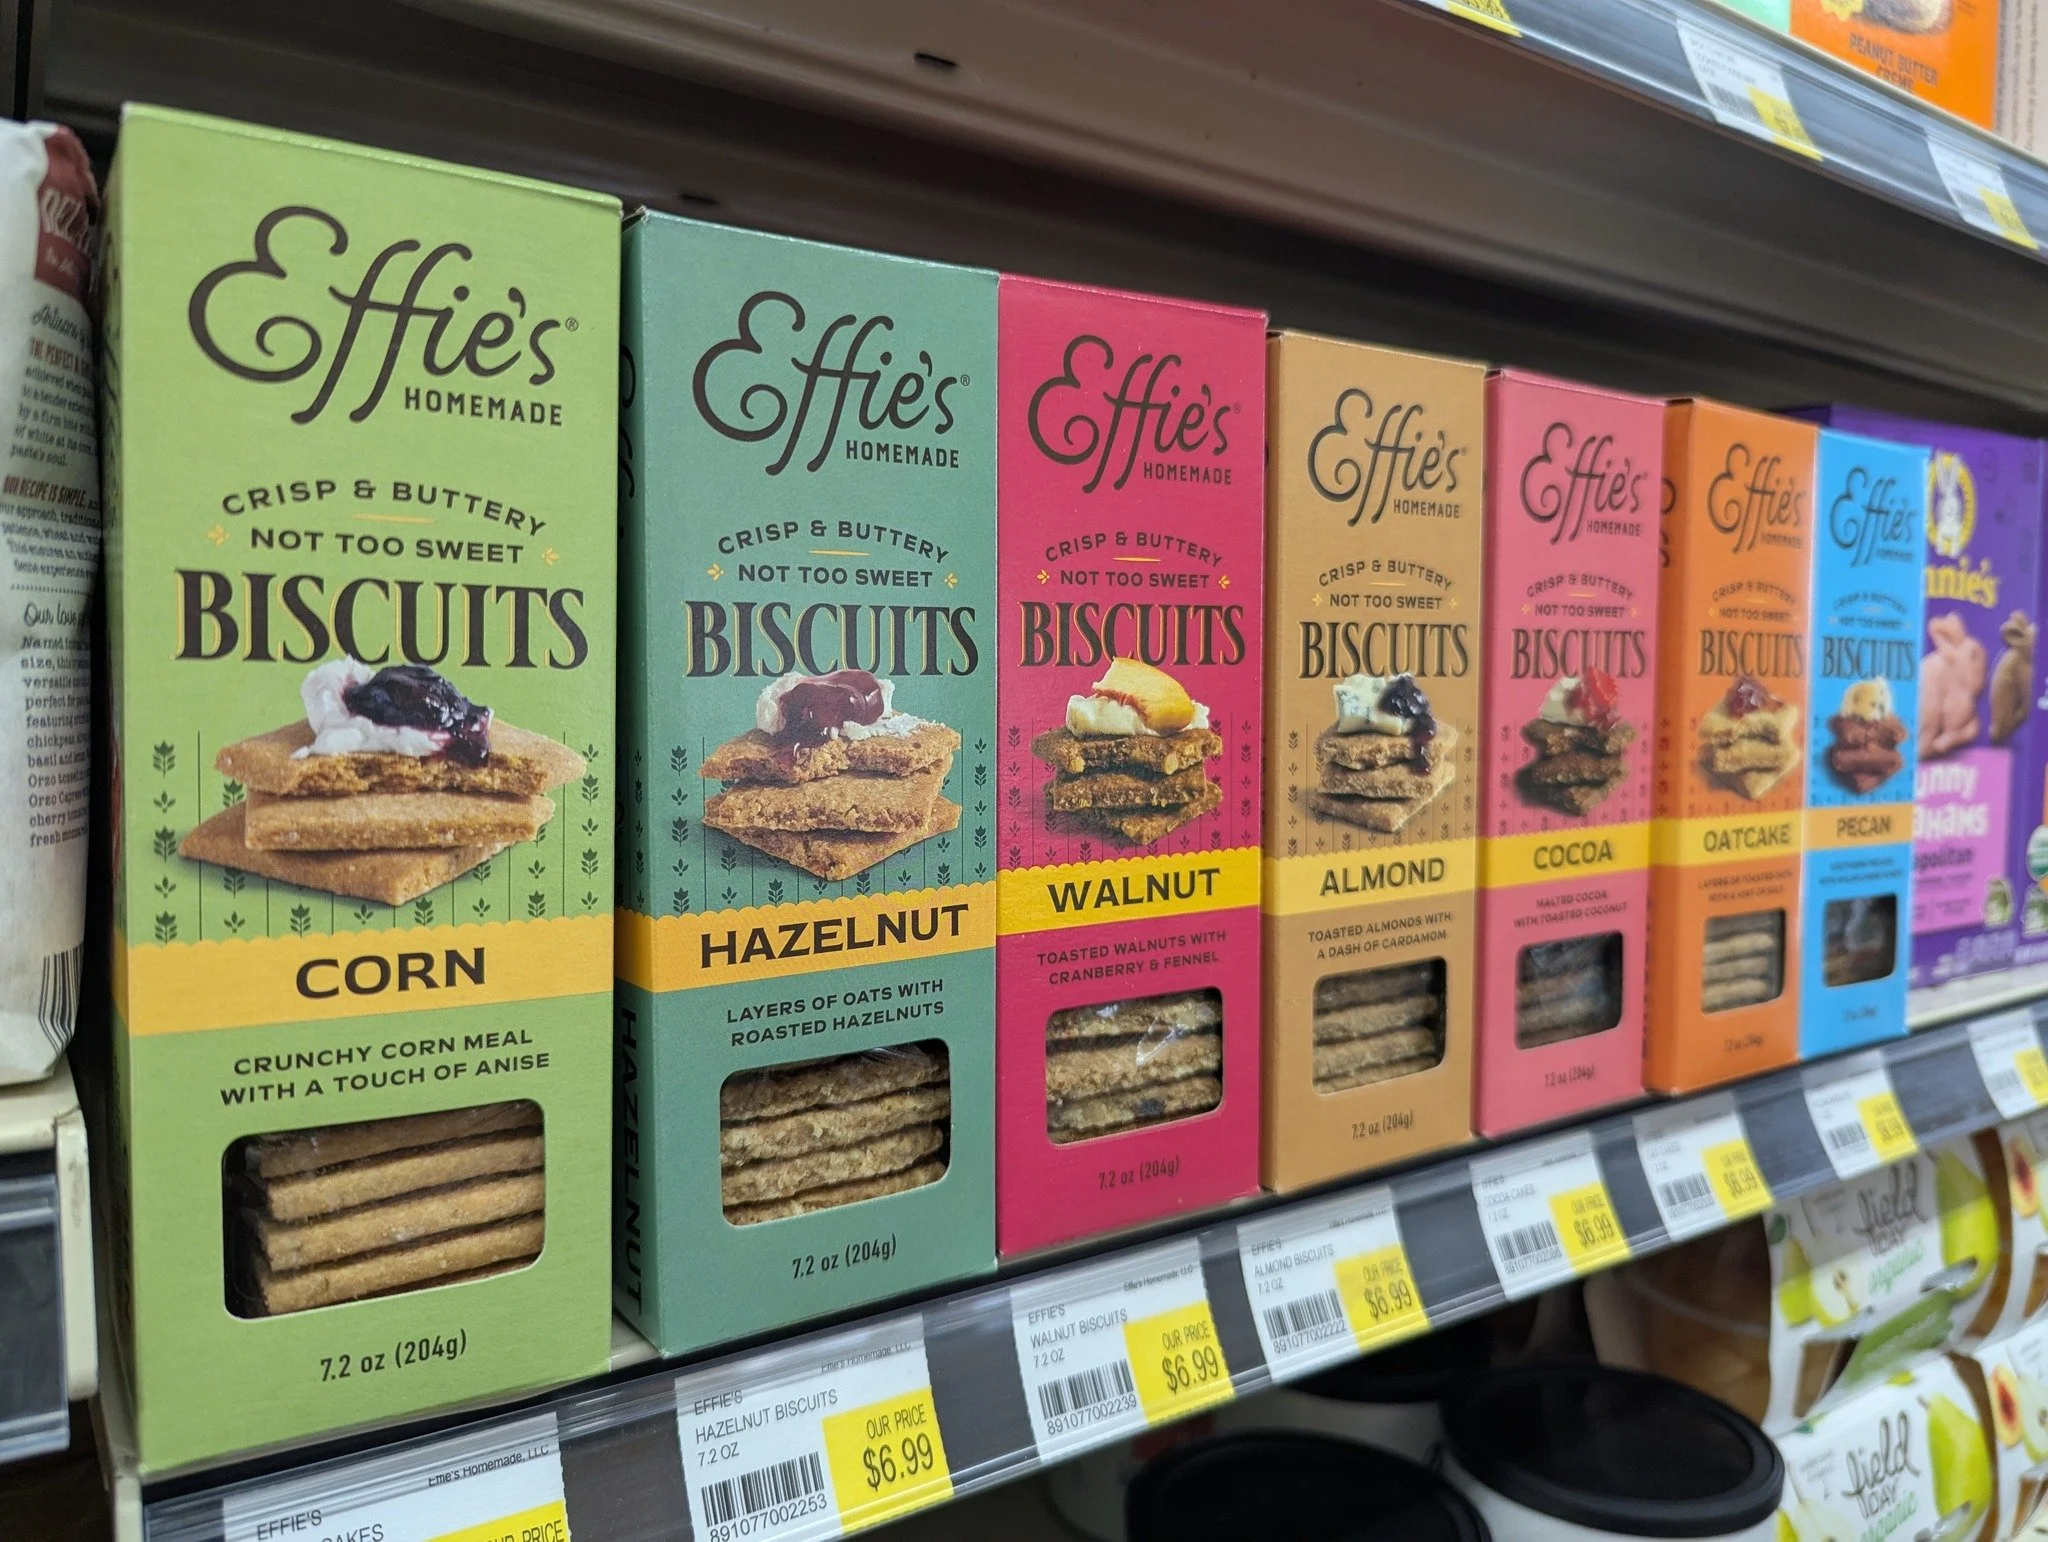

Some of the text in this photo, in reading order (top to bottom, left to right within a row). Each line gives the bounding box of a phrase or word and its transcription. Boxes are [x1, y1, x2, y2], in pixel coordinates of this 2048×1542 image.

[1849, 32, 1939, 87] PEANUT BUTTER
[189, 206, 560, 425] Effie's
[693, 291, 957, 476] Effie's
[404, 386, 563, 427] HOMEMADE
[1028, 335, 1231, 494] Effie's
[846, 440, 960, 468] HOMEMADE
[1143, 462, 1232, 486] HOMEMADE
[1306, 388, 1460, 527] Effie's
[1519, 422, 1642, 545] Effie's
[1707, 443, 1806, 554] Effie's
[222, 479, 548, 538] CRISP & BUTTERY
[1393, 499, 1460, 519] HOMEMADE
[1586, 520, 1641, 537] HOMEMADE
[1829, 467, 1918, 568] Effie's
[251, 528, 525, 564] NOT TOO SWEET
[718, 520, 949, 565] CRISP & BUTTERY
[1045, 531, 1222, 568] CRISP & BUTTERY
[739, 564, 932, 588] NOT TOO SWEET
[1060, 570, 1209, 589] NOT TOO SWEET
[1318, 559, 1452, 591] CRISP & BUTTERY
[1527, 575, 1563, 598] CRISP
[1581, 574, 1633, 601] BUTTERY
[173, 569, 590, 670] BISCUITS
[1329, 594, 1443, 610] NOT TOO SWEET
[1535, 604, 1625, 618] NOT TOO SWEET
[684, 600, 979, 677] BISCUITS
[1016, 601, 1246, 667] BISCUITS
[1298, 621, 1469, 679] BISCUITS
[1510, 628, 1646, 679] BISCUITS
[1698, 629, 1804, 678] BISCUITS
[1820, 636, 1914, 680] BISCUITS
[1703, 823, 1791, 852] OATCAKE
[1836, 816, 1891, 838] PECAN
[1319, 856, 1445, 897] ALMOND
[1533, 839, 1613, 871] COCOA
[1047, 867, 1221, 913] WALNUT
[700, 904, 969, 969] HAZELNUT
[1037, 929, 1227, 967] TOASTED WALNUTS WITH
[1308, 911, 1452, 943] TOASTED ALMONDS WITH
[1316, 929, 1447, 960] A DASH OF CARDAMOM
[296, 948, 487, 999] CORN
[1049, 951, 1219, 985] CRANBERRY & FENNEL
[727, 979, 944, 1024] LAYERS OF OATS WITH
[731, 1001, 944, 1047] ROASTED HAZELNUTS
[233, 1030, 533, 1076] CRUNCHY CORN MEAL
[220, 1052, 550, 1106] WITH A TOUCH OF ANISE
[621, 1006, 643, 1314] HAZELNUT
[1099, 1154, 1180, 1190] 7.2 oz (204g)
[1573, 1212, 1614, 1248] $6.99
[793, 1233, 897, 1279] 7.2 oz (204g)
[1254, 1243, 1334, 1278] ALMOND BISCUITS
[1028, 1304, 1065, 1325] EFFIE'S
[1364, 1280, 1413, 1324] $6.99
[1030, 1308, 1128, 1349] WALNUT BISCUITS
[1162, 1320, 1211, 1351] OUR PRICE
[320, 1328, 467, 1382] 7.2 oz (204g)
[1050, 1348, 1065, 1363] OZ
[1162, 1345, 1220, 1395] $6.99
[694, 1389, 744, 1416] EFFIE'S
[696, 1388, 838, 1444] HAZELNUT BISCUITS
[866, 1403, 928, 1440] OUR PRICE
[1047, 1393, 1137, 1436] 891077002239
[698, 1442, 740, 1467] 7.2 OZ
[863, 1432, 934, 1492] $6.99
[1841, 1408, 1920, 1497] field
[257, 1509, 322, 1541] EFFIE'S
[321, 1523, 384, 1542] AKES
[710, 1493, 828, 1542] 891077002253
